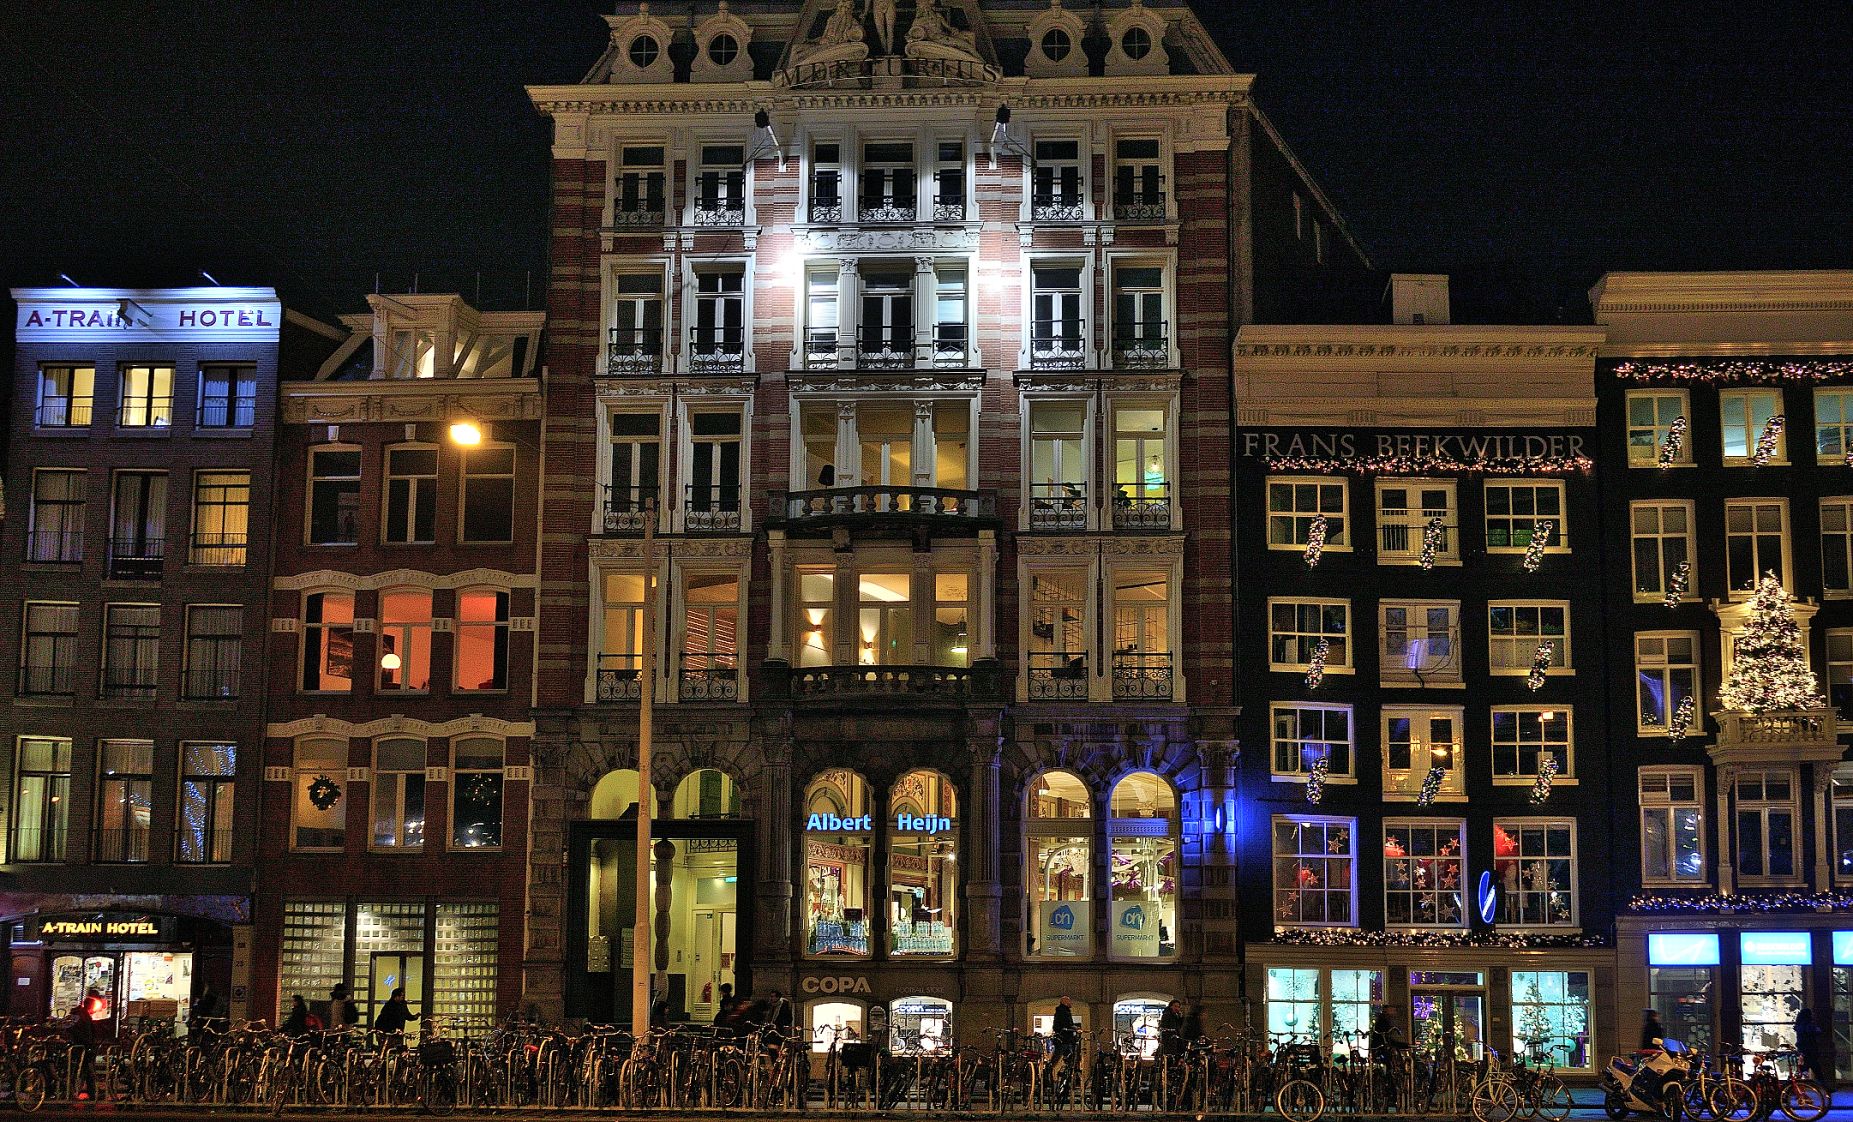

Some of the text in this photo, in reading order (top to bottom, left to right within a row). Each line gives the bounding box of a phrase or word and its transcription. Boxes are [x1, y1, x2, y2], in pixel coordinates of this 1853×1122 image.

[179, 310, 272, 327] HOTEL
[1242, 433, 1590, 460] FRANS BEEKWILDER
[806, 813, 951, 835] Albert Heijn
[41, 921, 159, 934] A-TRAIN HOTEL
[1045, 934, 1085, 942] SUPERMARKT
[802, 976, 872, 993] COPA
